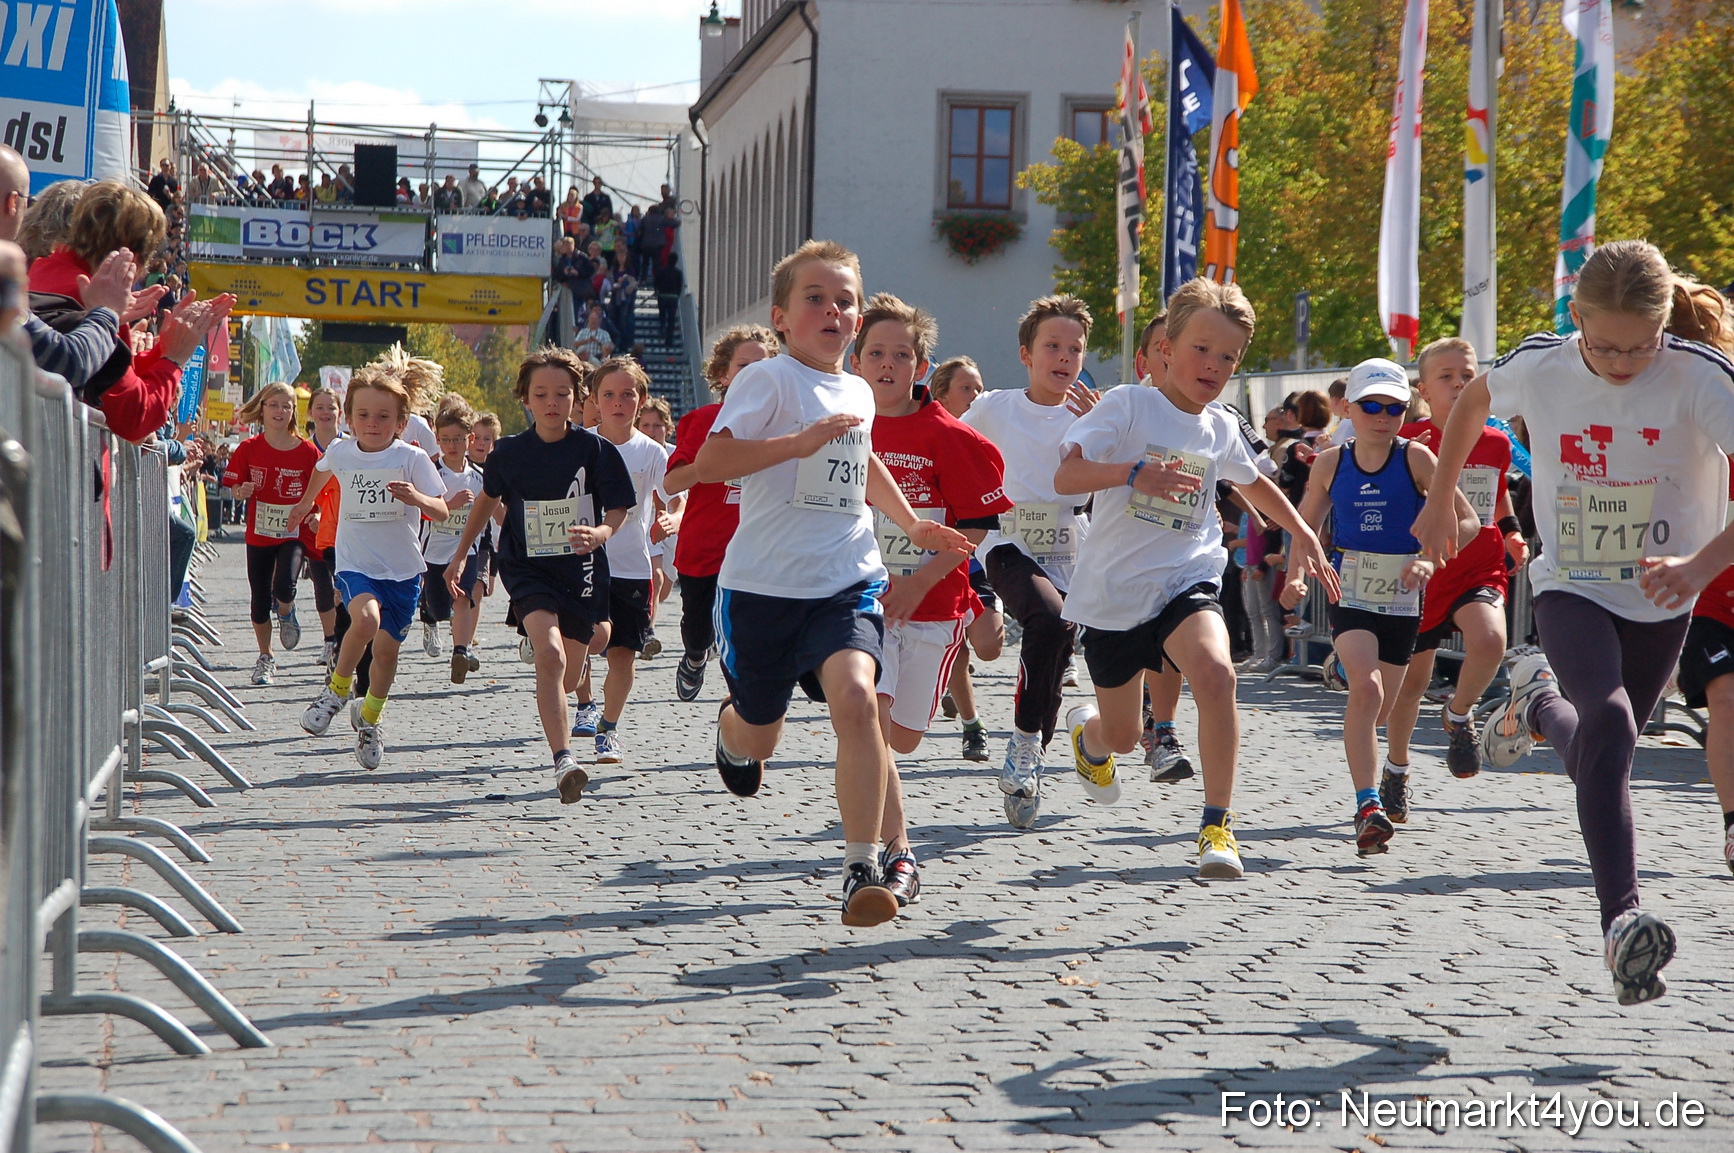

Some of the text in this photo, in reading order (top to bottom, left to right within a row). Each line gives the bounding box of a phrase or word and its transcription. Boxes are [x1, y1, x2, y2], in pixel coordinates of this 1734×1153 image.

[0, 0, 76, 71] xi
[4, 111, 68, 163] dsl
[244, 218, 380, 250] BOCK
[466, 233, 545, 249] PFLEIDERER
[466, 249, 545, 258] AKTIENGESELLSCHAFT
[305, 277, 426, 308] START
[881, 458, 924, 471] STADTLAUF
[883, 452, 934, 467] NEUMARKTER
[827, 459, 866, 487] 7316
[1466, 473, 1488, 485] Henri
[350, 473, 381, 489] Alex
[267, 506, 284, 515] Fanny
[543, 506, 570, 516] Josua
[1588, 494, 1627, 513] Anna
[1019, 508, 1047, 521] Petar
[527, 522, 532, 531] K
[1361, 523, 1383, 531] Bank
[1561, 521, 1576, 536] K5
[1020, 527, 1070, 546] 7235
[1590, 519, 1670, 550] 7170
[1362, 557, 1378, 569] Nic
